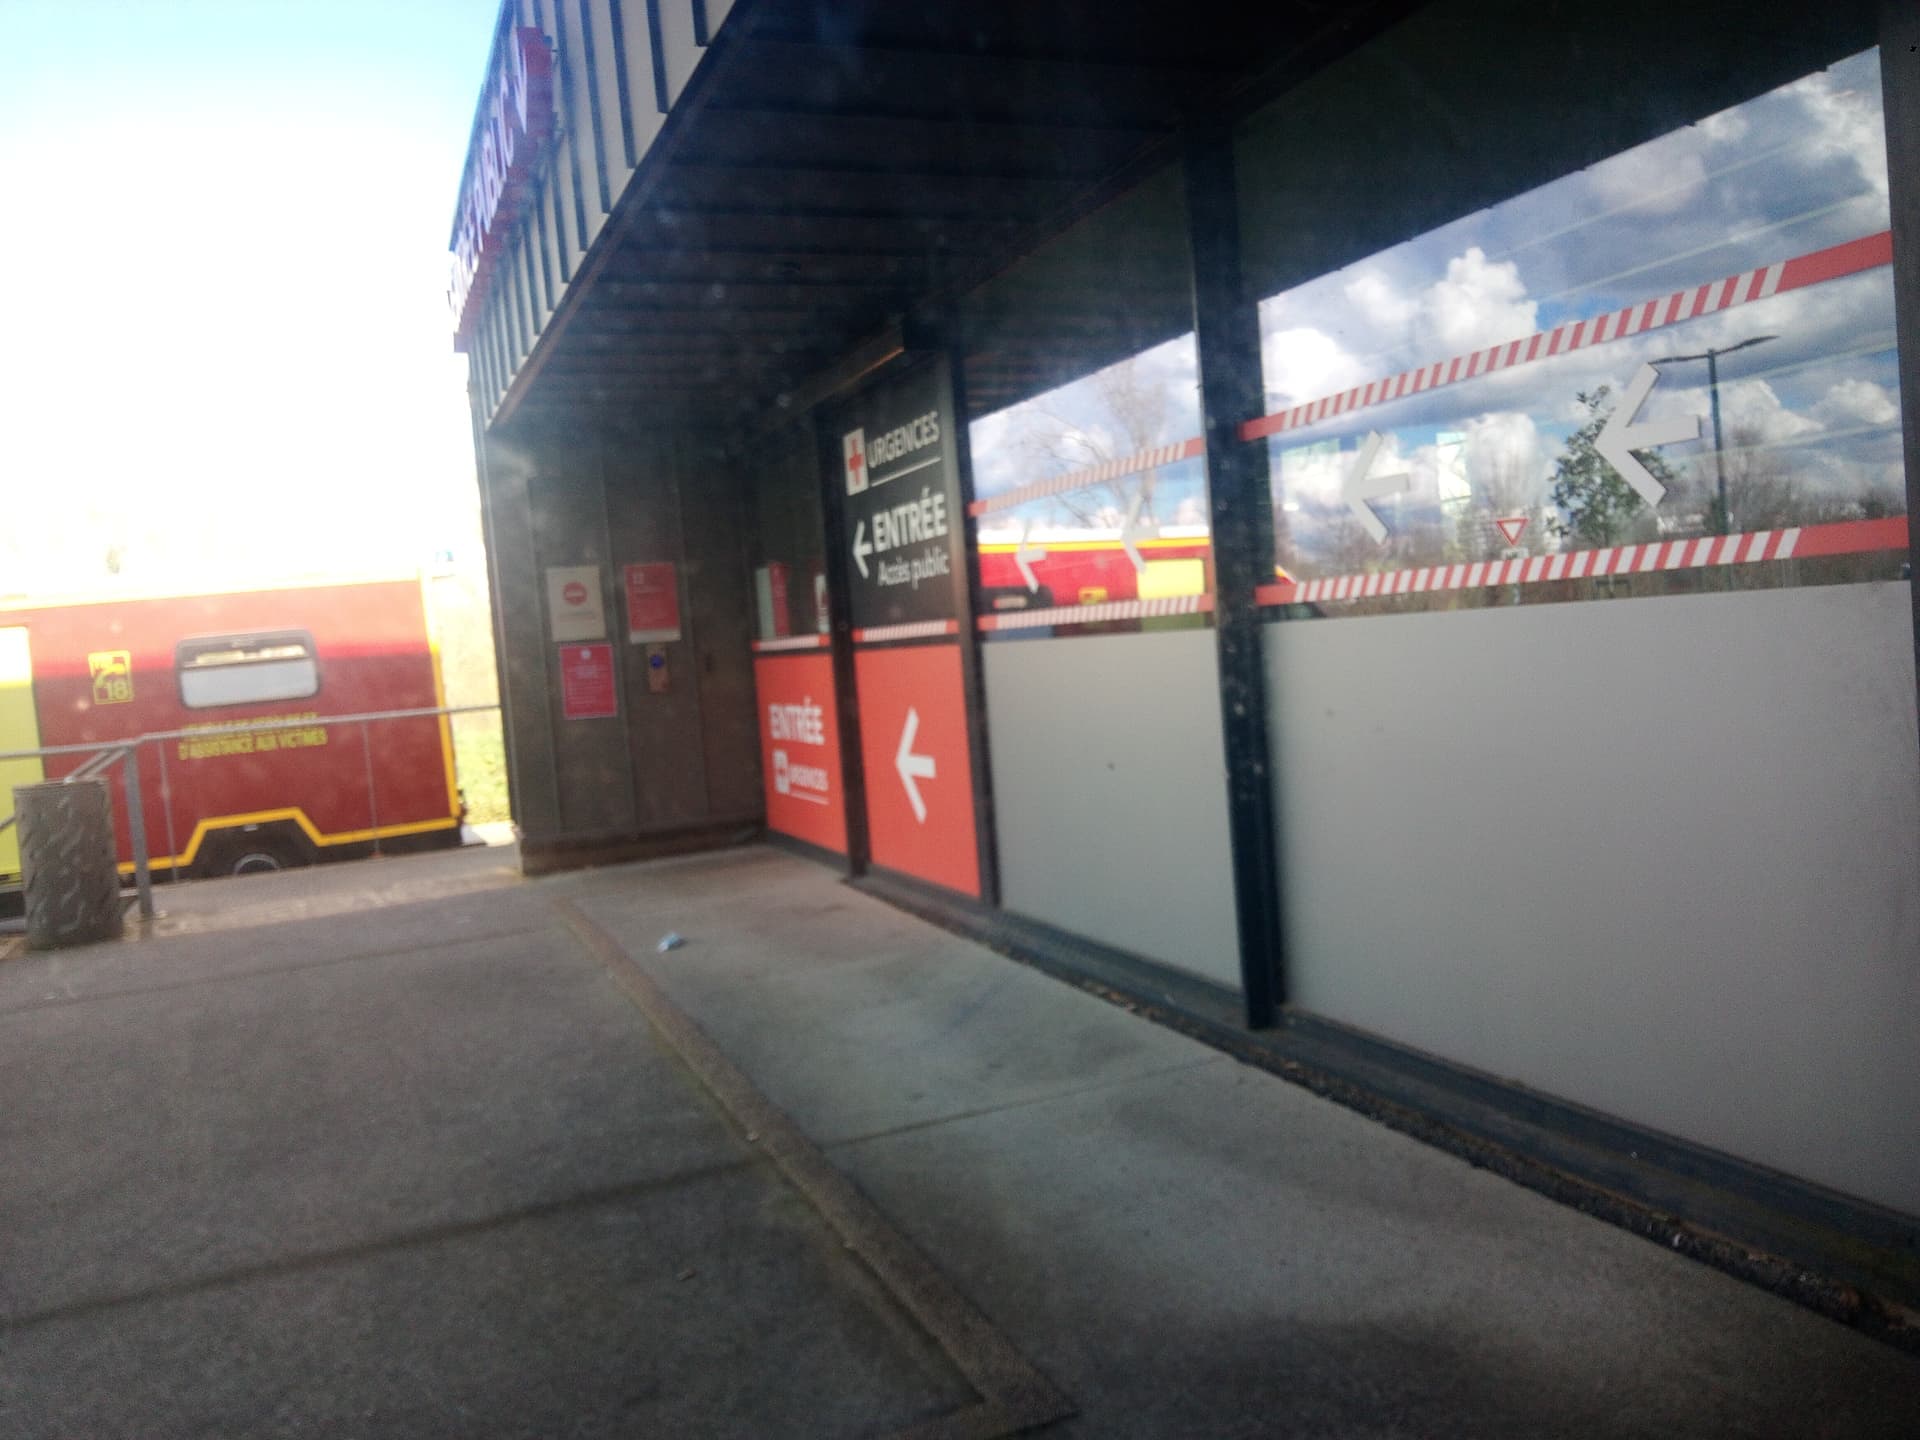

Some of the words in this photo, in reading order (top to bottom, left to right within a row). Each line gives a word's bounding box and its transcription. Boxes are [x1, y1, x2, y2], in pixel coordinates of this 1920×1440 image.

[868, 411, 940, 469] URGENCES
[872, 486, 948, 552] ENTRÉE
[877, 557, 911, 587] Accès
[911, 545, 950, 591] public
[104, 680, 129, 700] 18
[768, 695, 825, 745] ENTRÉE
